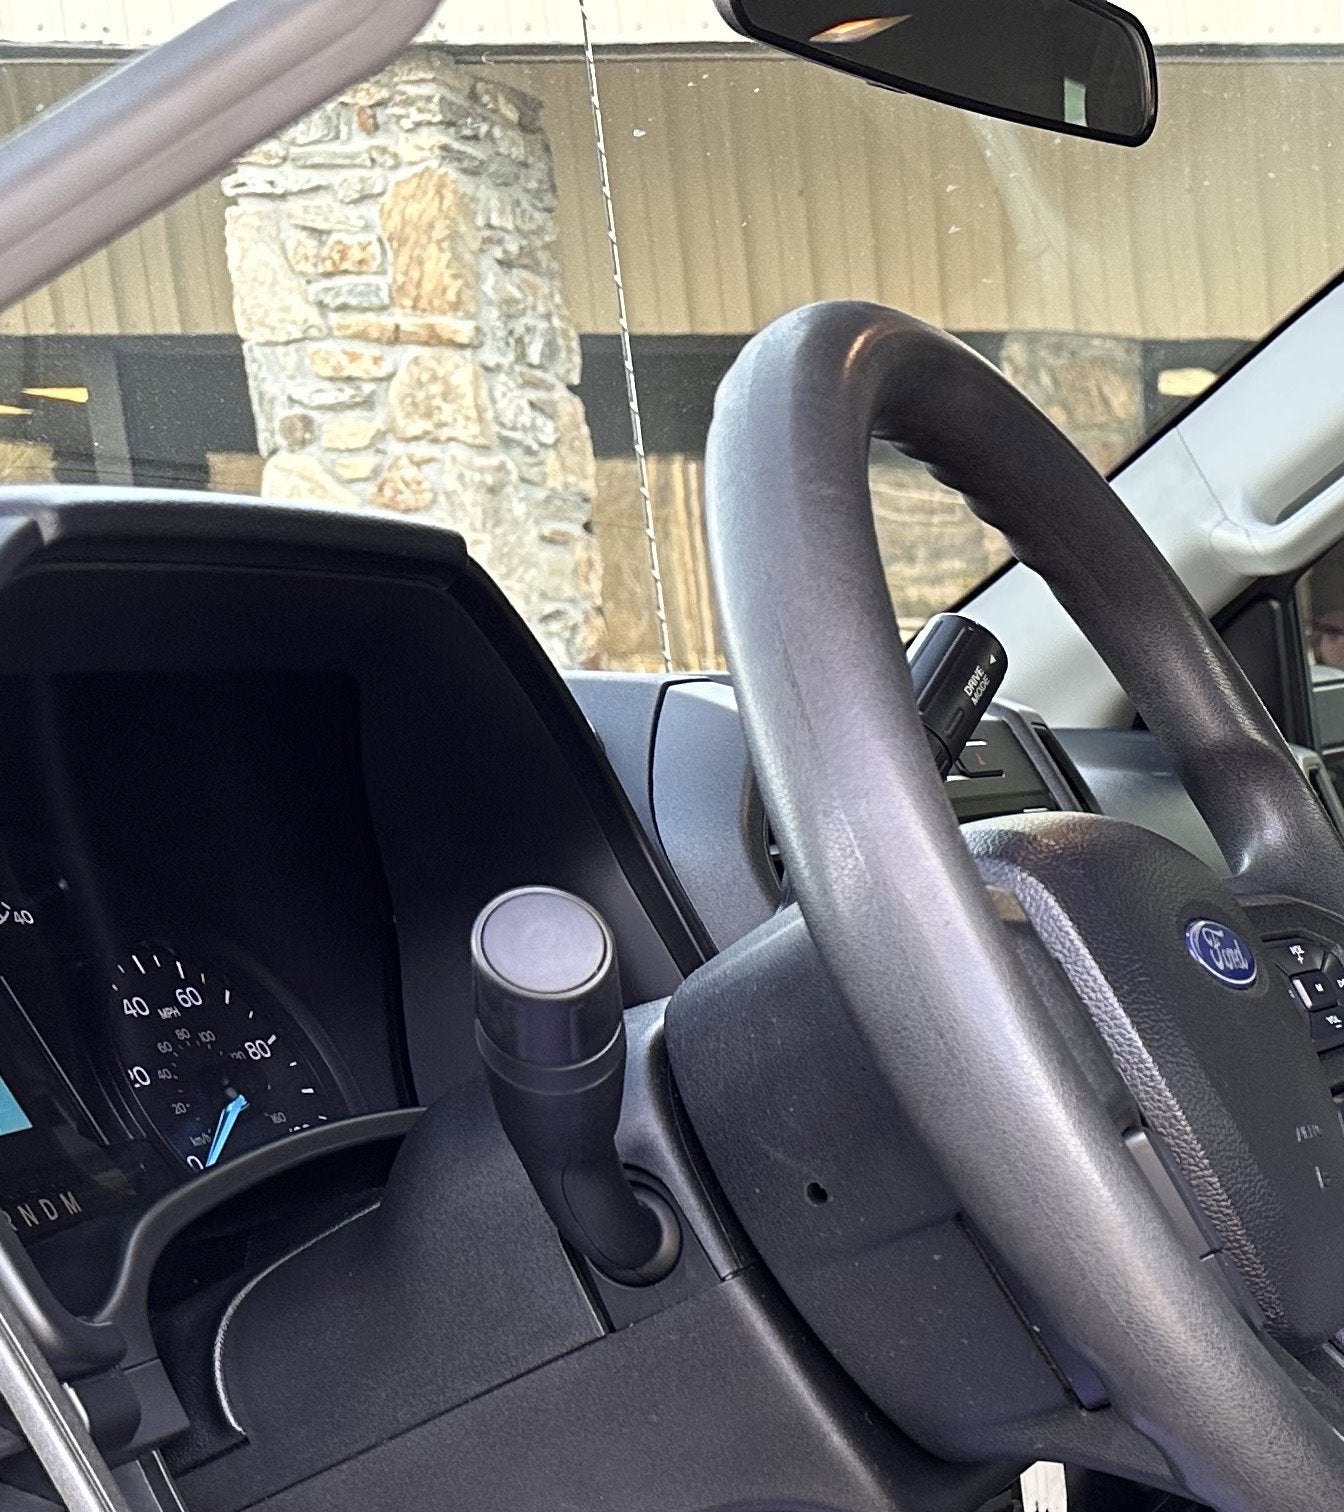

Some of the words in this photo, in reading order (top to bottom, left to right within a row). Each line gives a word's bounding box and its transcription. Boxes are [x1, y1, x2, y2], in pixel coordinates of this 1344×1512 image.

[963, 664, 985, 697] DRIVE
[970, 673, 991, 706] MODE
[13, 909, 35, 925] 40
[1202, 927, 1250, 971] Ford
[175, 986, 203, 1008] 60
[122, 996, 150, 1018] 40
[157, 1005, 182, 1020] MPH
[198, 1029, 216, 1043] 100
[156, 1040, 173, 1054] 60
[244, 1039, 272, 1061] 80
[157, 1068, 173, 1081] 40
[171, 1102, 187, 1115] 20
